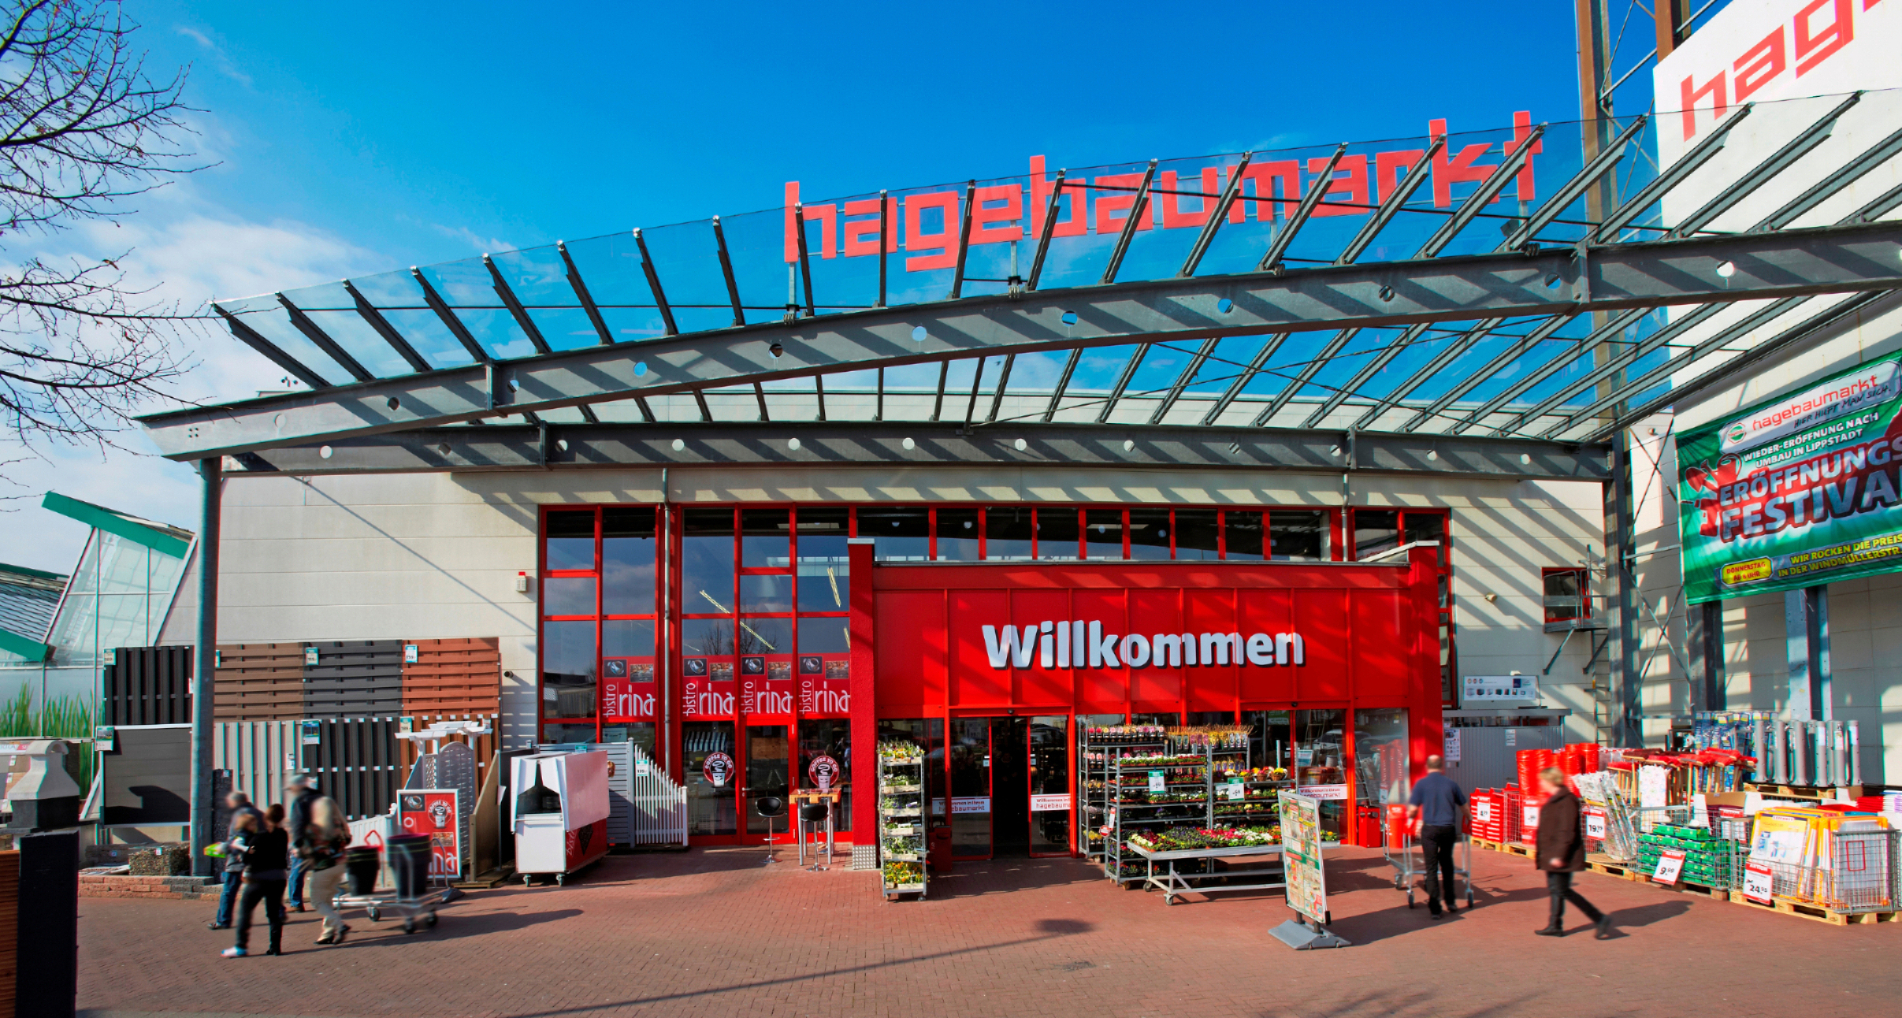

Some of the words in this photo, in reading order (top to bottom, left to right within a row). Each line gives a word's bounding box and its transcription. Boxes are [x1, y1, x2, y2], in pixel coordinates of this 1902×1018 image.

[1680, 0, 1882, 142] hag
[785, 111, 1543, 273] hagebaumarkt
[1752, 375, 1878, 432] hagebaumarkt
[1842, 392, 1865, 409] MAN
[1744, 423, 1844, 462] WIEDER-ERÖFFNUNG
[1845, 412, 1879, 430] NACH
[1755, 450, 1792, 469] UMBAU
[1794, 446, 1804, 457] IN
[1805, 428, 1863, 453] LIPPSTADT
[1722, 464, 1902, 540] FESTIVA
[1791, 553, 1810, 564] WIR
[1811, 544, 1851, 560] ROCKEN
[1853, 540, 1870, 552] DIE
[1778, 568, 1789, 577] IN
[1789, 564, 1808, 575] DER
[982, 620, 1304, 668] Willkommen
[603, 684, 616, 718] bistro
[619, 684, 656, 717] rina
[682, 682, 696, 717] bistro
[699, 682, 735, 716] rina
[740, 681, 754, 715] bistro
[757, 682, 793, 714] rina
[799, 680, 812, 714] bistro
[815, 681, 850, 713] rina
